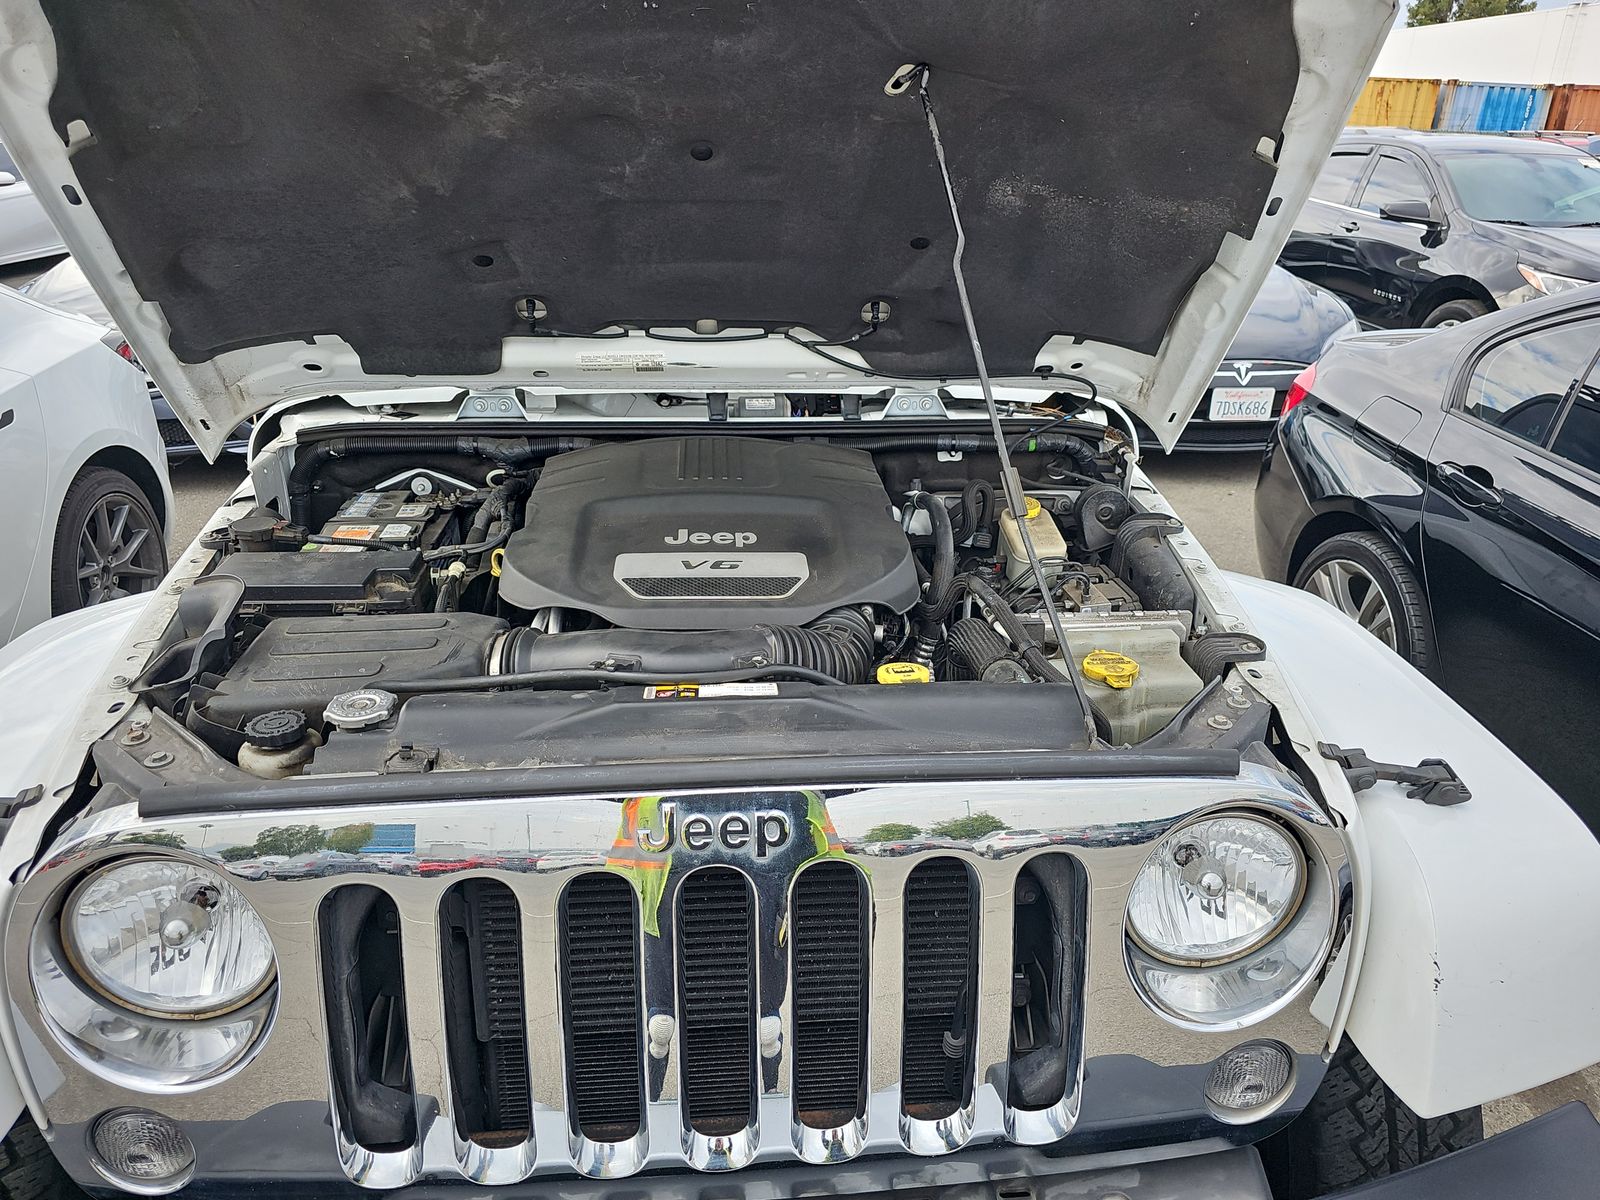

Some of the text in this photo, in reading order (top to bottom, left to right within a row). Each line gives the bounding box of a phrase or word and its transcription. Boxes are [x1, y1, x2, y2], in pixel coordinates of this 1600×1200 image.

[1216, 401, 1268, 416] 7DSK686
[664, 528, 758, 548] Jeep
[681, 560, 743, 570] V6
[637, 802, 791, 859] Jeep
